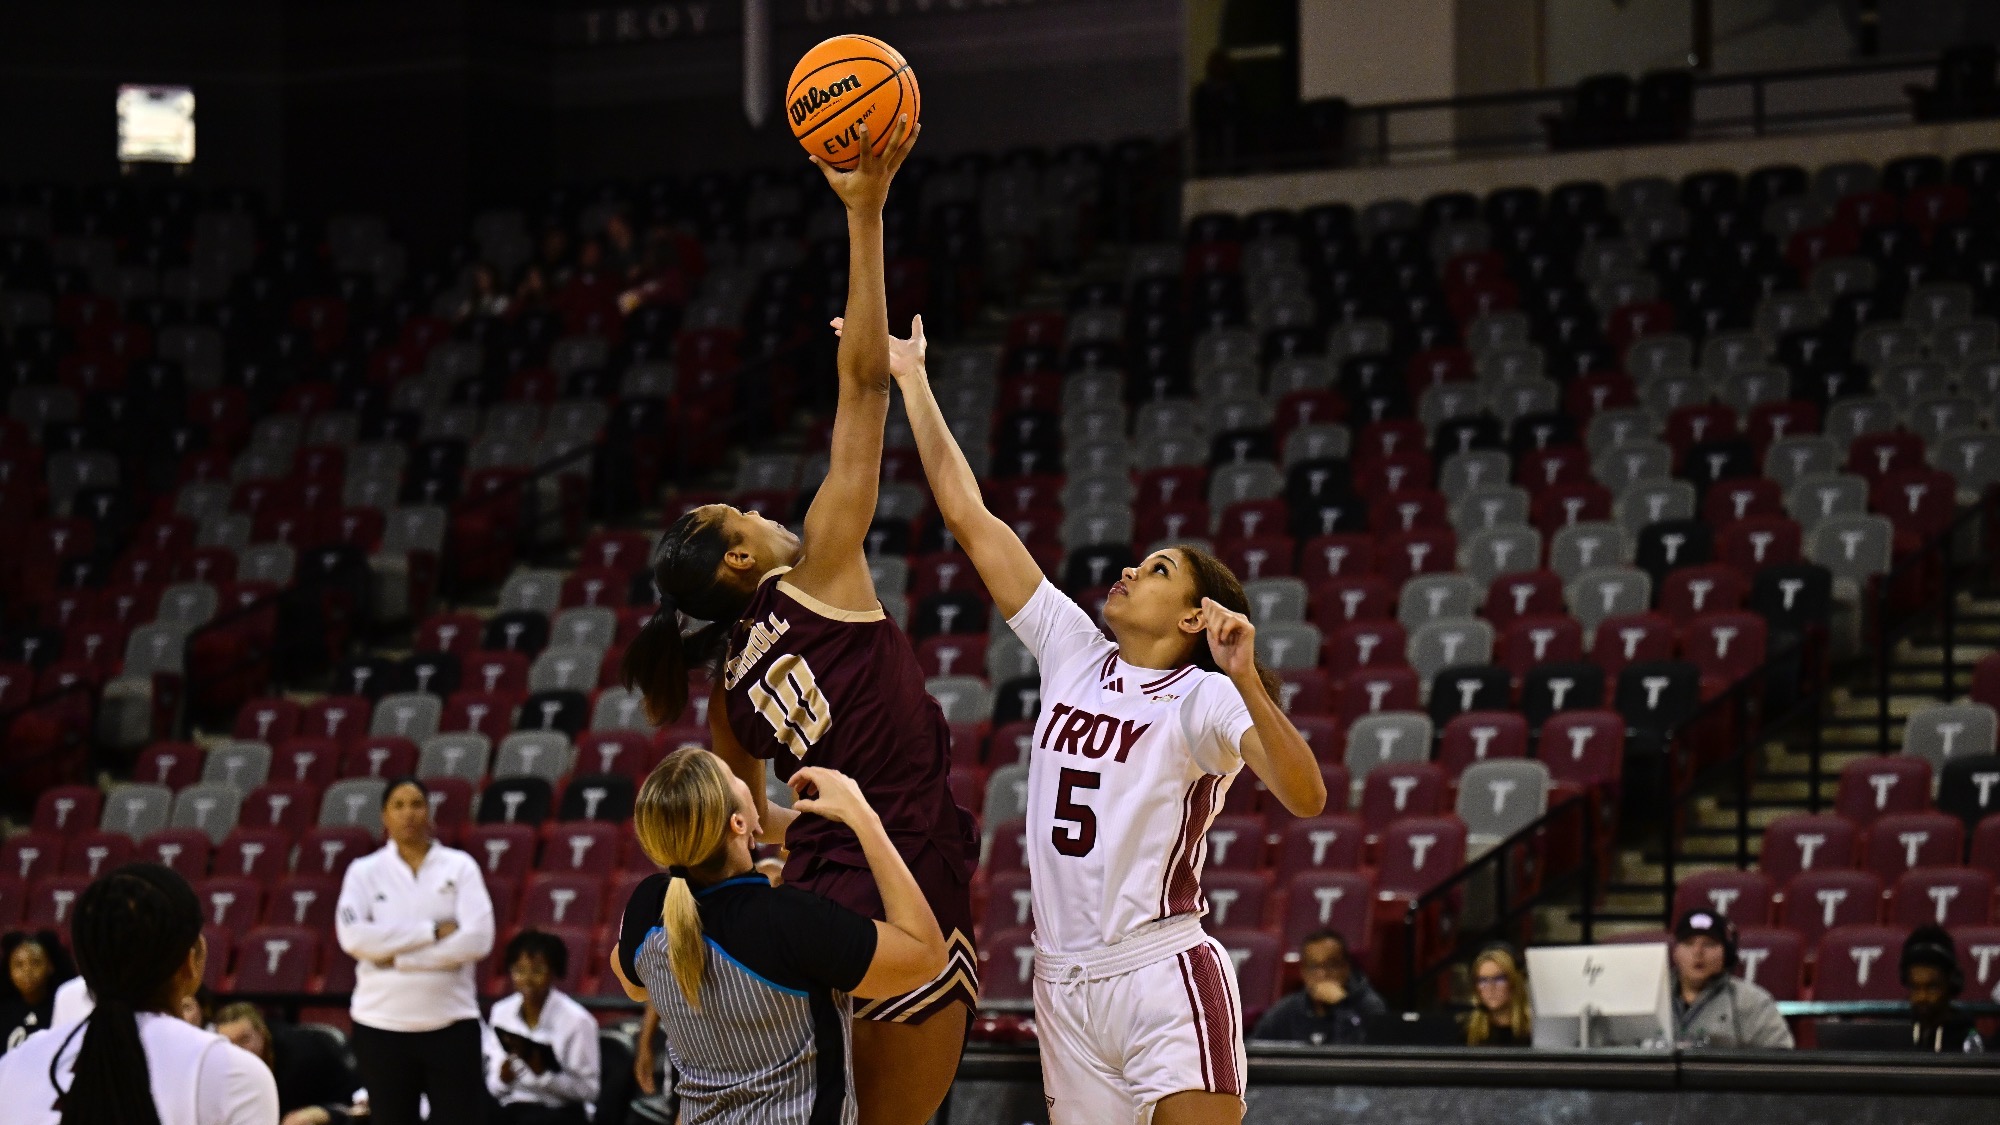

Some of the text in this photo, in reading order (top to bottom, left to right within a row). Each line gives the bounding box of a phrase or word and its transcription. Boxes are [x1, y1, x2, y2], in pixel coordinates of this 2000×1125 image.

[580, 3, 710, 44] TROY
[789, 74, 863, 127] Wilson
[862, 102, 877, 120] NXT
[1533, 425, 1552, 450] T
[1544, 458, 1562, 485] T
[1708, 454, 1727, 480] T
[1876, 447, 1895, 474] T
[1309, 470, 1327, 496] T
[1386, 466, 1405, 492] T
[1564, 498, 1585, 525] T
[1647, 494, 1668, 522] T
[1732, 491, 1752, 519] T
[1819, 489, 1839, 518] T
[1905, 484, 1926, 514] T
[1166, 515, 1186, 539] T
[1242, 511, 1261, 538] T
[1321, 508, 1339, 535] T
[1399, 503, 1420, 531] T
[601, 542, 621, 566] T
[1325, 546, 1347, 575] T
[1408, 543, 1430, 572] T
[1491, 540, 1514, 569] T
[1576, 537, 1600, 566] T
[1662, 534, 1685, 564] T
[1750, 532, 1773, 563] T
[1840, 531, 1863, 561] T
[937, 563, 957, 591] T
[1088, 557, 1108, 582] T
[1246, 550, 1266, 578] T
[584, 580, 605, 606] T
[1256, 592, 1281, 620] T
[1341, 590, 1365, 620] T
[1425, 587, 1450, 617] T
[1512, 584, 1534, 614] T
[1599, 582, 1622, 612] T
[1689, 580, 1713, 611] T
[1779, 579, 1803, 610] T
[938, 605, 959, 632] T
[437, 625, 458, 651] T
[505, 623, 524, 647] T
[1356, 634, 1380, 664] T
[1440, 632, 1465, 664] T
[1530, 629, 1554, 660] T
[1620, 628, 1645, 659] T
[1713, 627, 1737, 658] T
[935, 646, 960, 676] T
[1268, 637, 1292, 667] T
[353, 667, 371, 691] T
[416, 664, 435, 696] T
[483, 664, 503, 691] T
[747, 653, 833, 760] 10
[1366, 681, 1391, 713] T
[1457, 679, 1482, 711] T
[1548, 678, 1574, 710] T
[1643, 677, 1669, 709] T
[256, 710, 276, 737] T
[325, 708, 345, 736] T
[466, 704, 488, 732] T
[540, 700, 562, 727] T
[616, 697, 640, 726] T
[1040, 702, 1154, 764] TROY
[1376, 727, 1402, 760] T
[1471, 727, 1497, 760] T
[1568, 726, 1594, 760] T
[1936, 722, 1964, 757] T
[157, 754, 176, 782] T
[294, 752, 315, 781] T
[369, 748, 389, 777] T
[441, 746, 466, 773] T
[518, 744, 543, 773] T
[599, 742, 622, 774] T
[583, 788, 606, 819] T
[1390, 776, 1418, 811] T
[1488, 780, 1515, 814] T
[1869, 774, 1898, 809] T
[1972, 772, 2000, 807] T
[55, 798, 75, 827] T
[192, 797, 218, 827] T
[268, 794, 290, 824] T
[344, 793, 369, 822] T
[427, 791, 446, 822] T
[502, 791, 525, 822] T
[1051, 766, 1102, 858] 5
[19, 847, 39, 877] T
[87, 846, 109, 876] T
[240, 842, 264, 873] T
[321, 840, 344, 871] T
[485, 839, 509, 871] T
[569, 835, 594, 868] T
[1210, 831, 1237, 865] T
[1309, 830, 1337, 865] T
[1408, 834, 1436, 870] T
[1796, 834, 1825, 870] T
[1899, 832, 1928, 868] T
[53, 890, 75, 922] T
[211, 892, 235, 925] T
[292, 890, 316, 923] T
[550, 889, 576, 923] T
[1210, 890, 1238, 925] T
[1314, 887, 1343, 924] T
[1816, 889, 1847, 927] T
[1928, 886, 1959, 924] T
[265, 940, 290, 974] T
[1737, 948, 1769, 985] T
[1850, 946, 1883, 986] T
[1970, 945, 2000, 984] T
